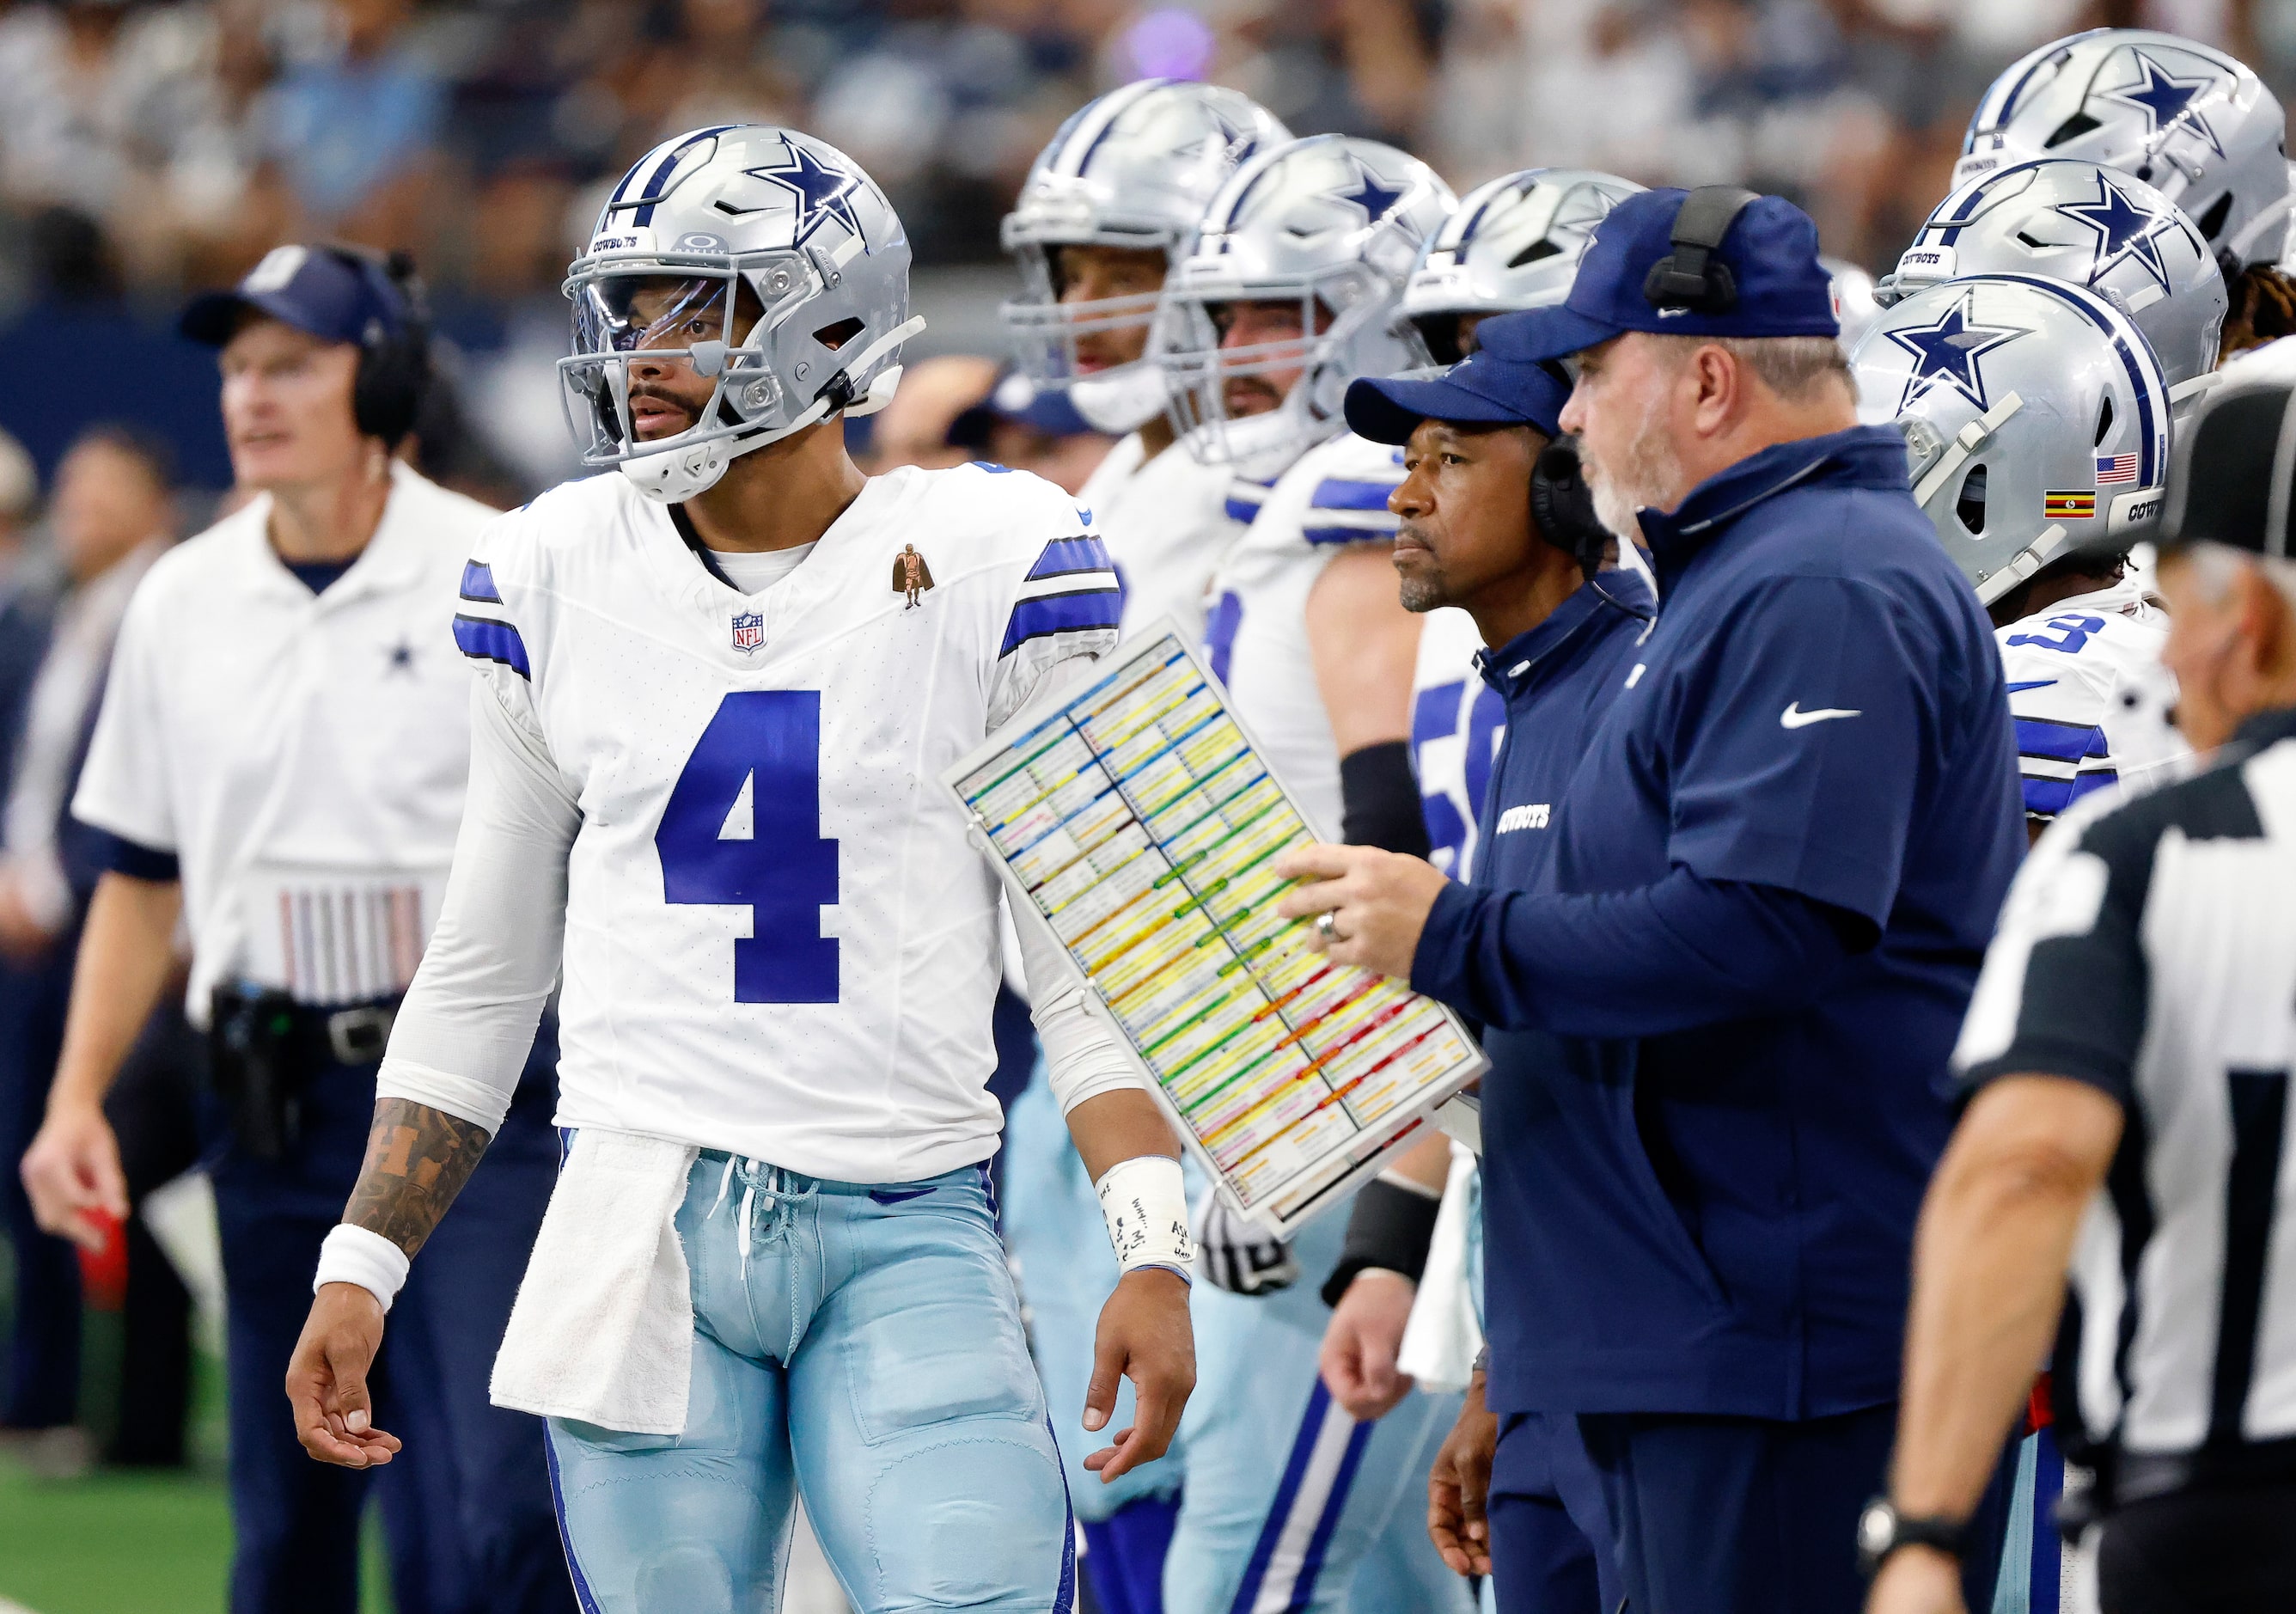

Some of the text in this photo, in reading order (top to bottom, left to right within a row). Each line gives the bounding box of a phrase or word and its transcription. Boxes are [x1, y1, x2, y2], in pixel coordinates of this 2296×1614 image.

[593, 236, 638, 253] COWBOYS
[736, 627, 761, 646] NFL
[2006, 613, 2107, 654] 3
[655, 690, 839, 1004] 4
